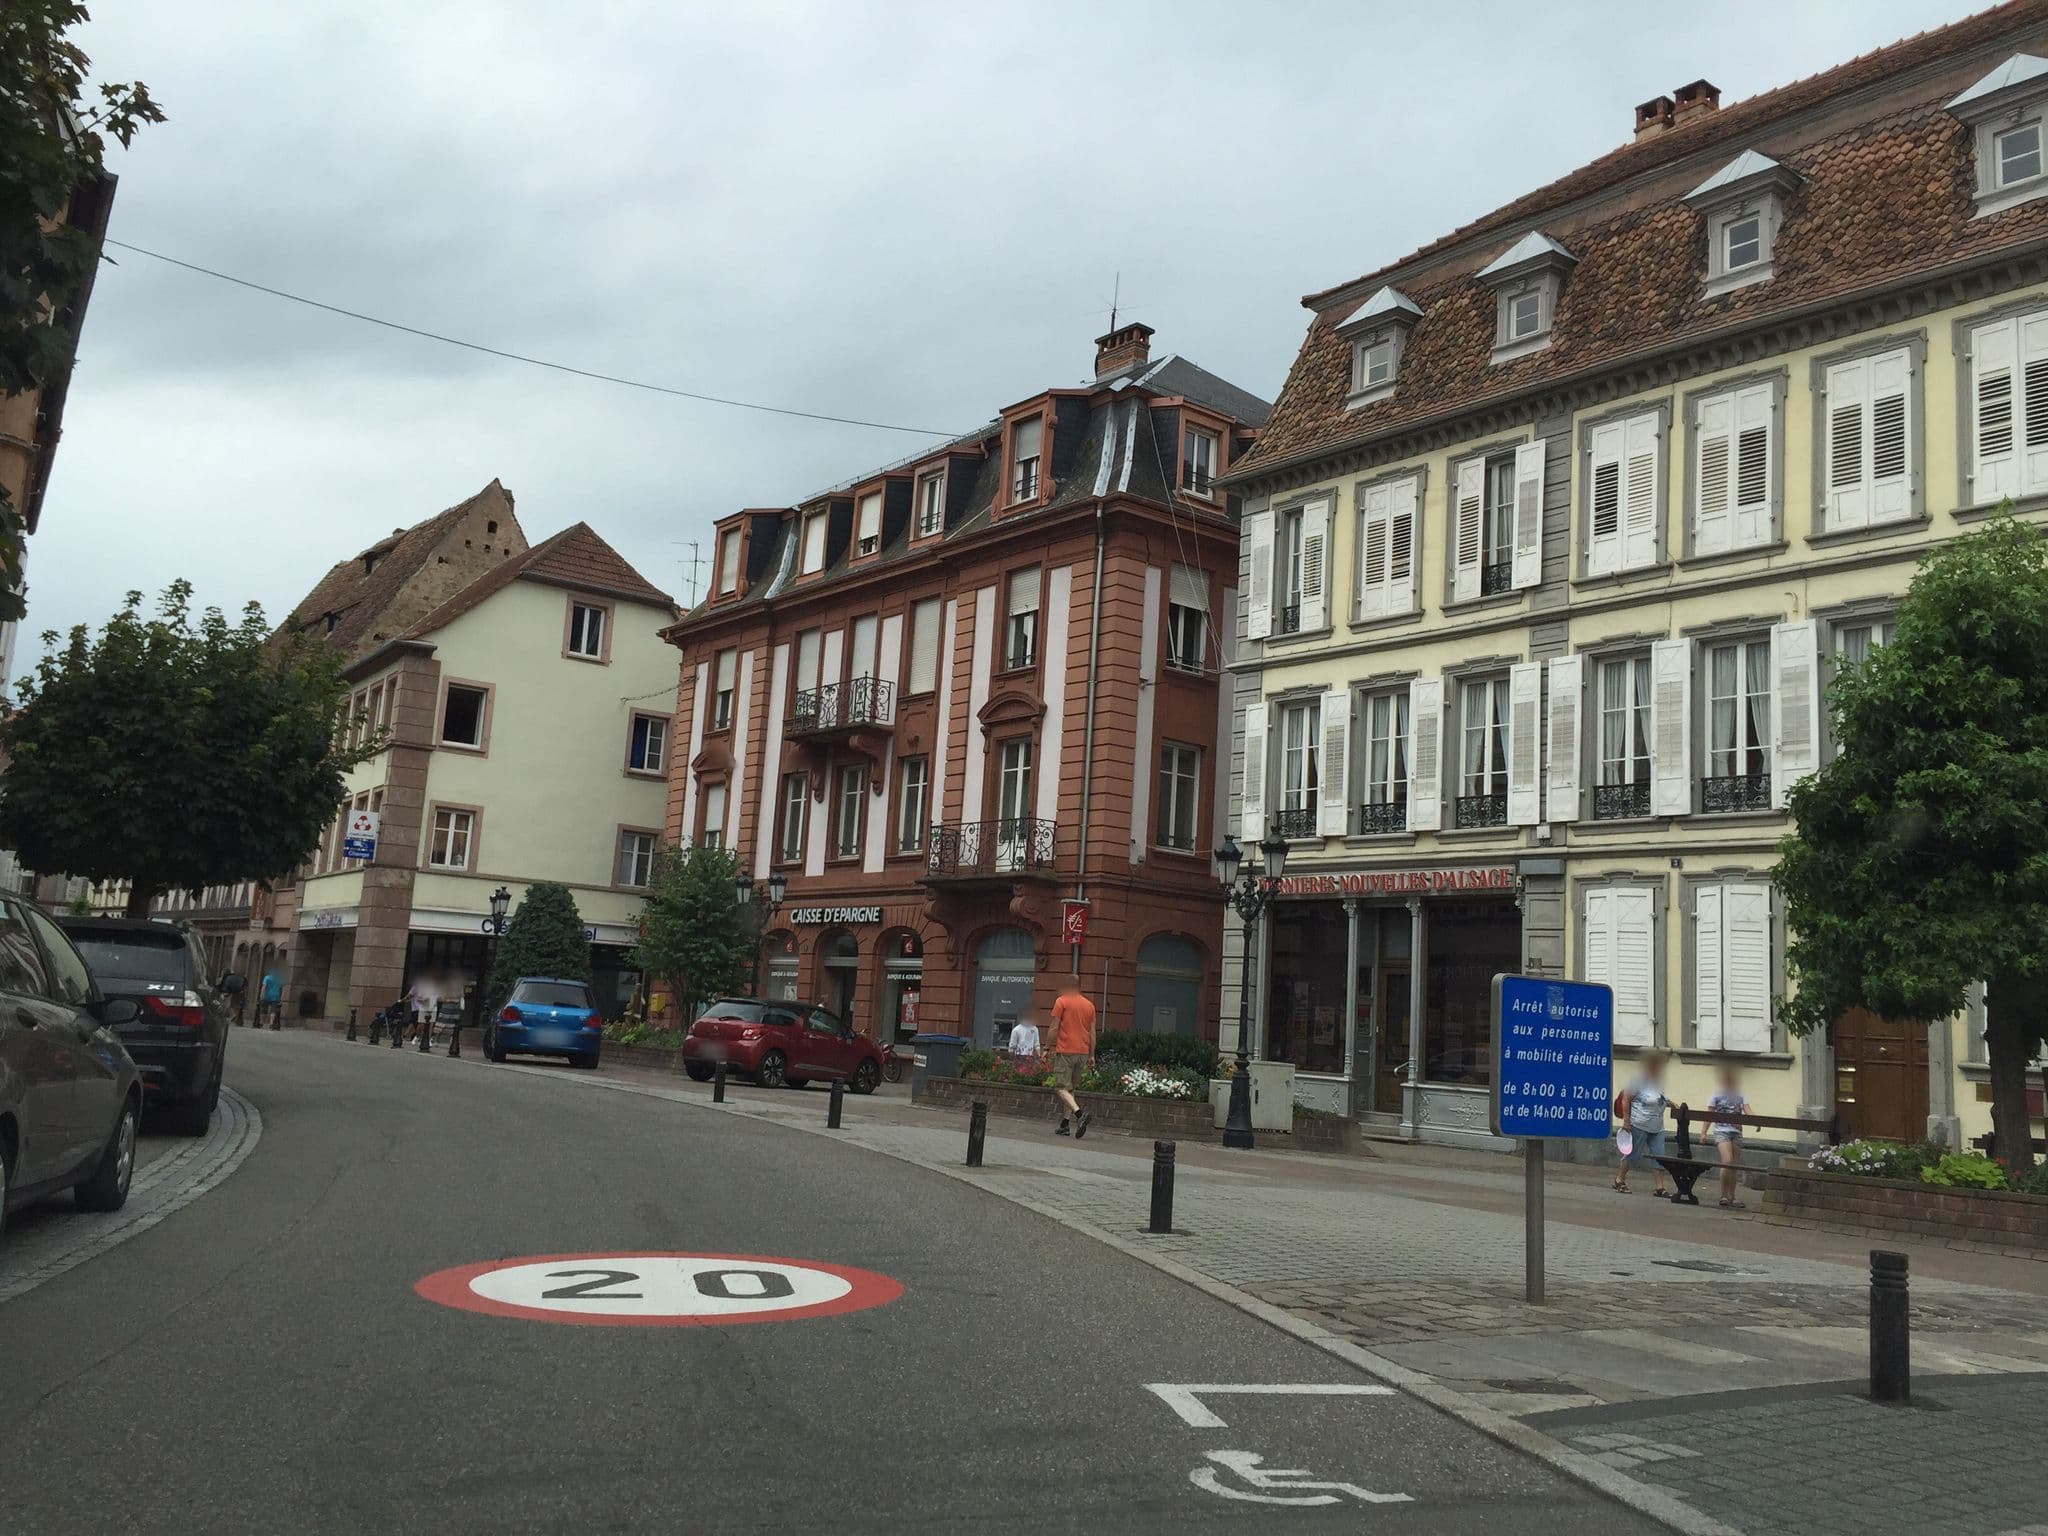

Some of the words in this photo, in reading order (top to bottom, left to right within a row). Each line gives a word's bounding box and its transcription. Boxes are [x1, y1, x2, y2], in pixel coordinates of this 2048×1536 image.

[1339, 871, 1427, 893] NOUVELLES
[790, 908, 822, 924] CAISSE
[824, 906, 880, 923] D'EPARGNE
[1512, 999, 1543, 1013] Arrêt
[1551, 1005, 1598, 1019] autorisé
[1513, 1024, 1533, 1036] aux
[1541, 1027, 1600, 1042] personnes
[1504, 1046, 1511, 1059] à
[1516, 1049, 1563, 1063] mobilité
[1568, 1053, 1607, 1066] réduite
[1503, 1081, 1517, 1095] de
[1522, 1083, 1555, 1097] 8h00
[1560, 1085, 1567, 1098] à
[1572, 1086, 1607, 1100] 12h00
[1503, 1106, 1514, 1117] et
[1517, 1105, 1530, 1117] de
[1533, 1104, 1565, 1119] 14h00
[1567, 1106, 1574, 1120] à
[1577, 1107, 1607, 1121] 18h00
[541, 1269, 795, 1299] 20
